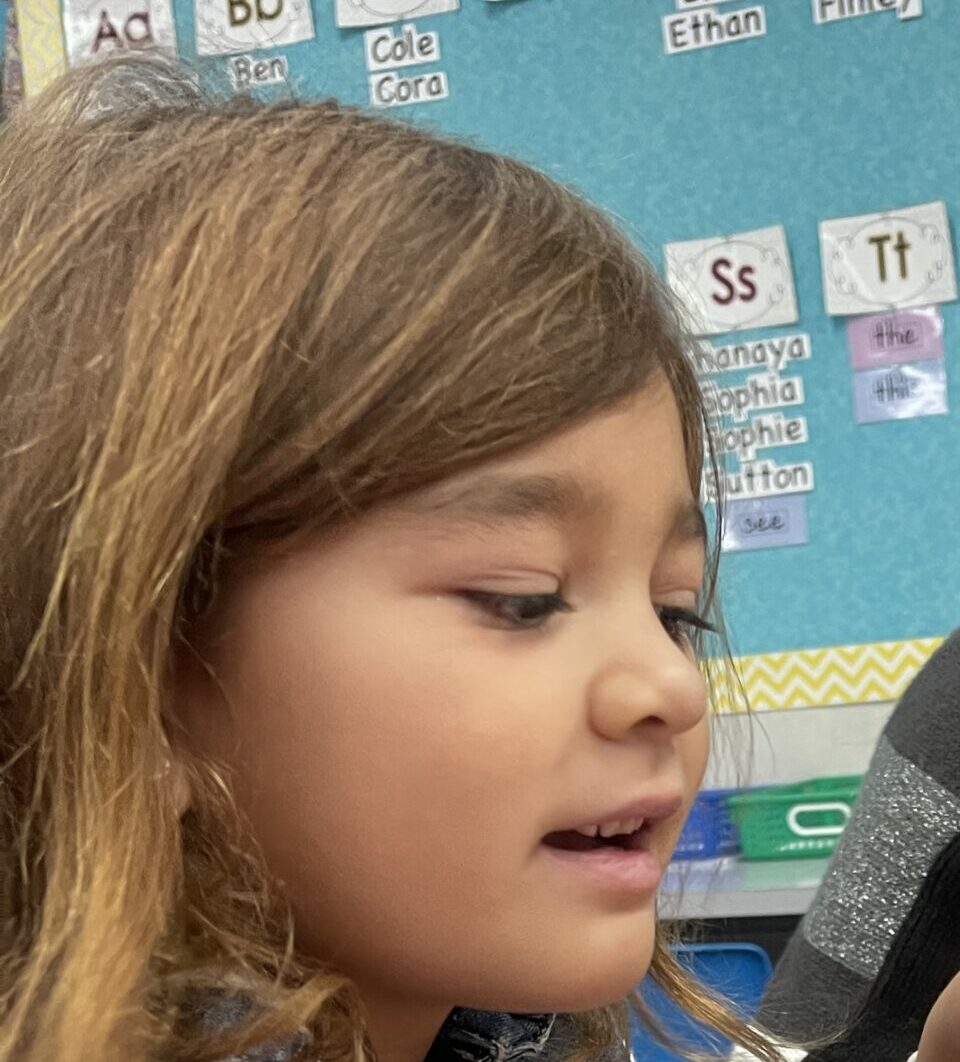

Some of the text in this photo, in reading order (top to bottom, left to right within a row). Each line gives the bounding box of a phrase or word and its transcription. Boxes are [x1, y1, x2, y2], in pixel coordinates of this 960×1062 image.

[90, 9, 155, 54] Aa
[370, 29, 436, 63] Cole
[668, 10, 762, 48] Ethan
[234, 57, 287, 87] Ben
[375, 75, 444, 103] Cora
[867, 230, 912, 283] Tt
[711, 257, 758, 306] Ss
[697, 337, 806, 376] hanaya
